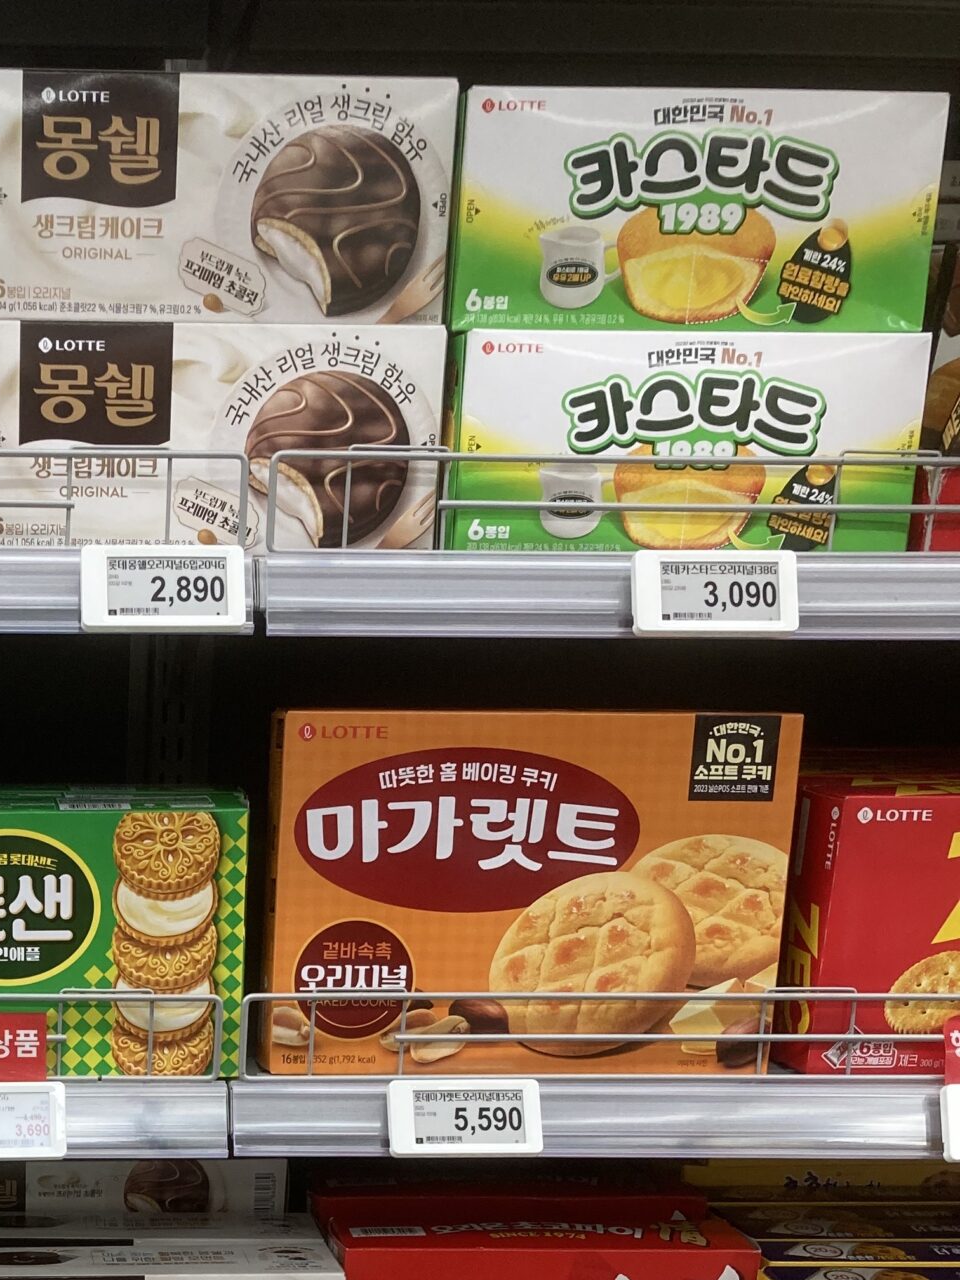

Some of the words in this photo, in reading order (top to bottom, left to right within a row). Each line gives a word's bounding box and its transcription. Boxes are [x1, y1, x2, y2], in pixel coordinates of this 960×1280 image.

[58, 90, 109, 102] LOTTE
[498, 100, 546, 111] LOTTE
[654, 105, 724, 126] 대한민국
[730, 105, 773, 126] No.1
[36, 115, 162, 185] 몽쉘
[569, 133, 833, 207] 카스타드
[659, 202, 745, 235] 1989
[62, 247, 132, 261] ORIGINAL
[465, 289, 508, 310] 6봉입
[33, 362, 156, 427] 몽쉘
[568, 377, 819, 451] 카스타드
[151, 575, 225, 607] 2,890
[704, 581, 777, 610] 3,090
[321, 726, 389, 739] LOTTE
[706, 739, 765, 764] No.1
[379, 763, 435, 790] 따뜻한
[439, 763, 457, 782] 홈
[462, 762, 517, 785] 베이킹
[520, 767, 559, 793] 쿠키
[694, 764, 738, 781] 소프트
[742, 764, 773, 781] 쿠키
[694, 784, 707, 793] 2023
[876, 809, 932, 822] LOTTE
[306, 796, 621, 872] 마가렛트
[323, 942, 392, 960] 겉바속촉
[299, 964, 408, 992] 오리지널
[15, 1124, 50, 1138] 3,690
[454, 1106, 523, 1134] 5,590
